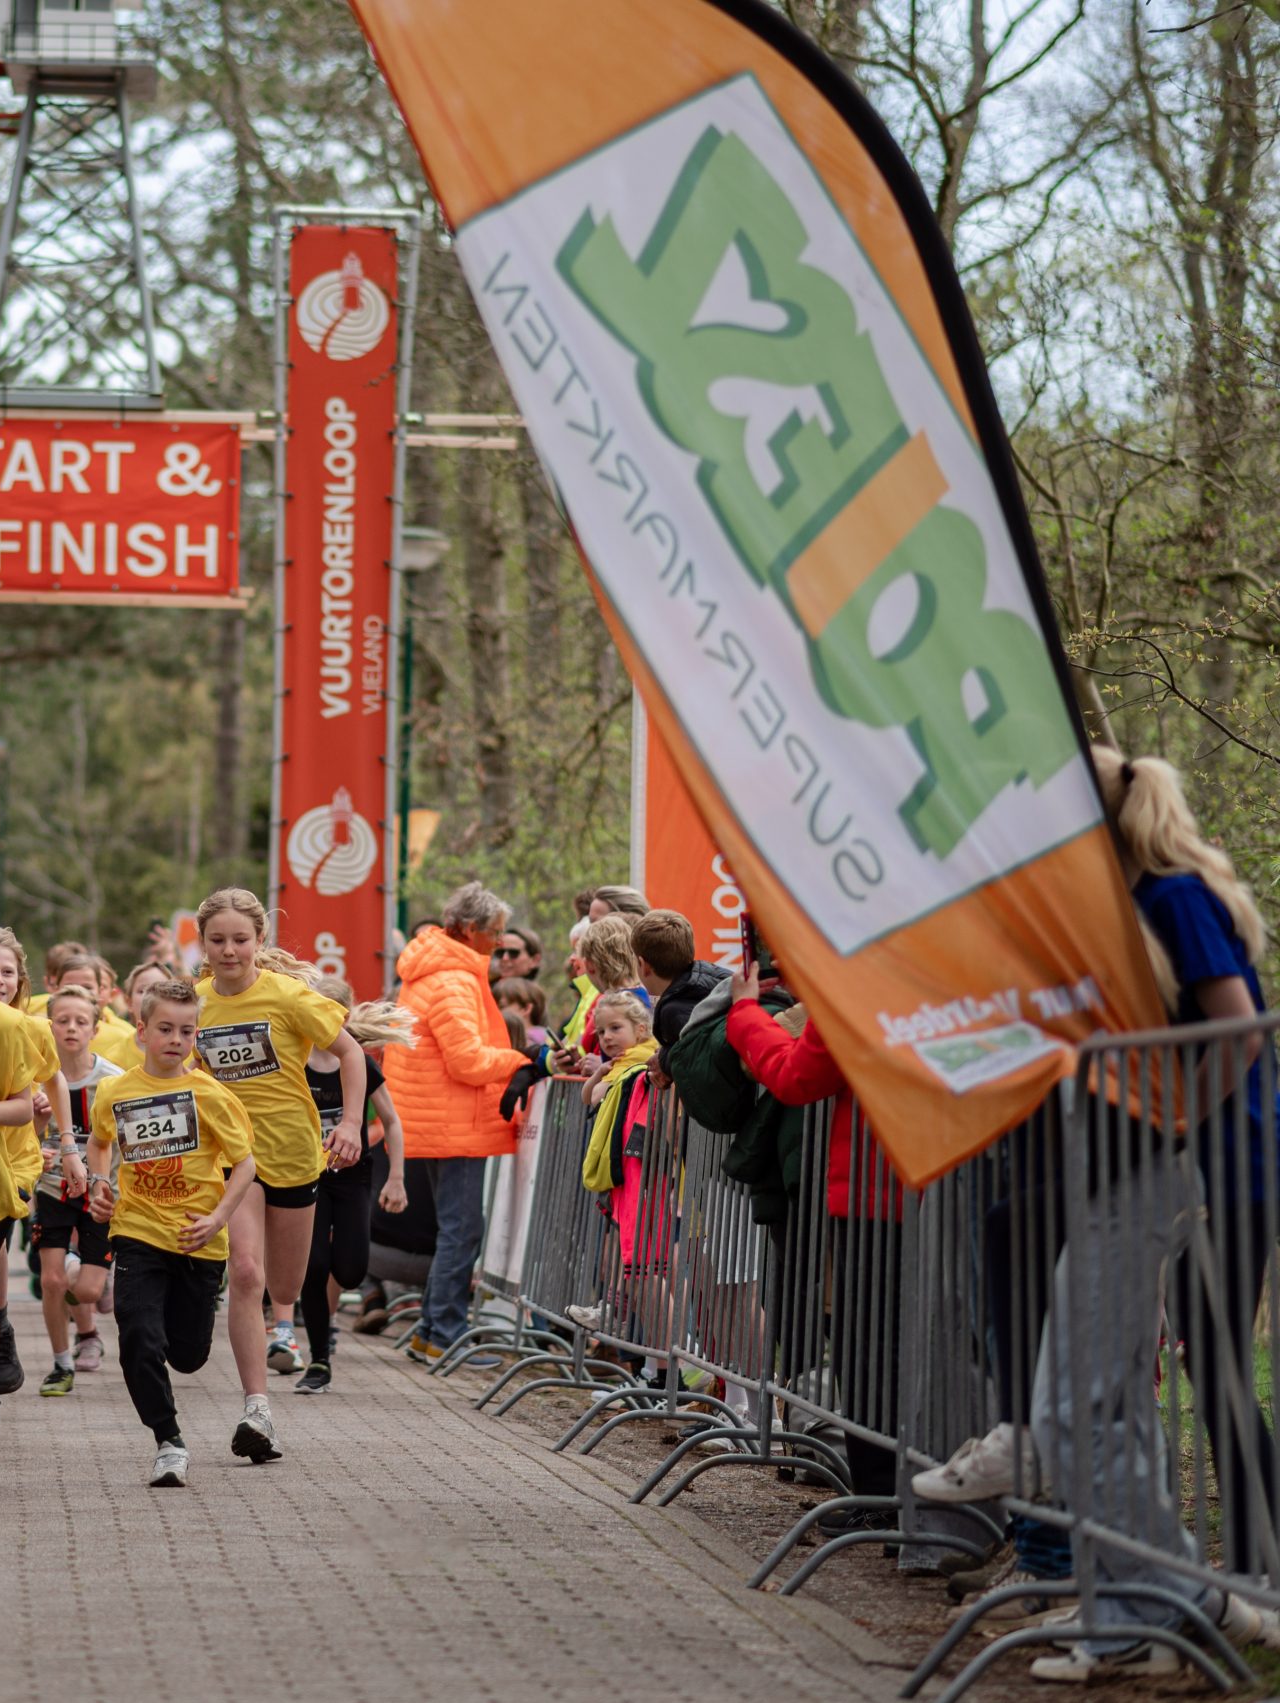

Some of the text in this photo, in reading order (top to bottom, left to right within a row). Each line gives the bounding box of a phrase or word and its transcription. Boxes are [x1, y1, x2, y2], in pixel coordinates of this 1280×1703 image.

[156, 442, 222, 497] &
[319, 396, 357, 719] VUURTORENLOOP
[362, 615, 384, 716] VLIELAND
[217, 1047, 254, 1065] 202
[240, 1062, 277, 1077] Vlieland
[136, 1119, 175, 1140] 234
[125, 1140, 196, 1160] Jan van Vlieland
[133, 1171, 187, 1190] 2026
